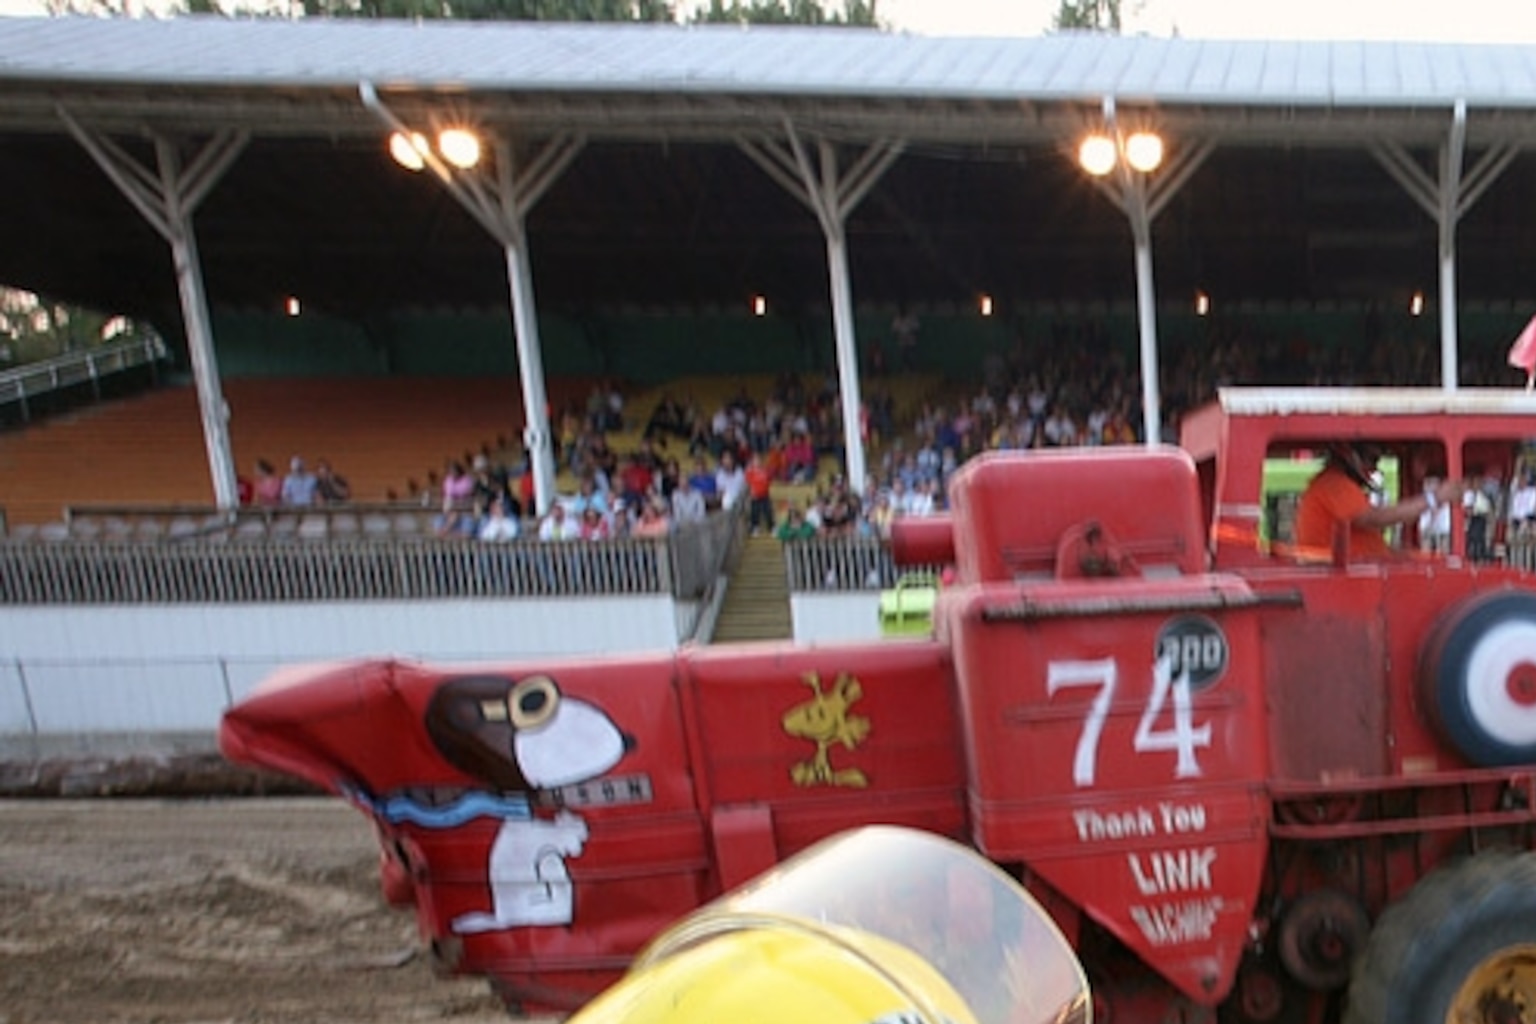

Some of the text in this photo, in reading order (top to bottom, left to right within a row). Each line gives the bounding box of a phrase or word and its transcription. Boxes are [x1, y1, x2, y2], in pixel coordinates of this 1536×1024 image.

[1047, 655, 1212, 788] 74
[1073, 801, 1206, 841] Thank You
[1128, 847, 1216, 895] LINK
